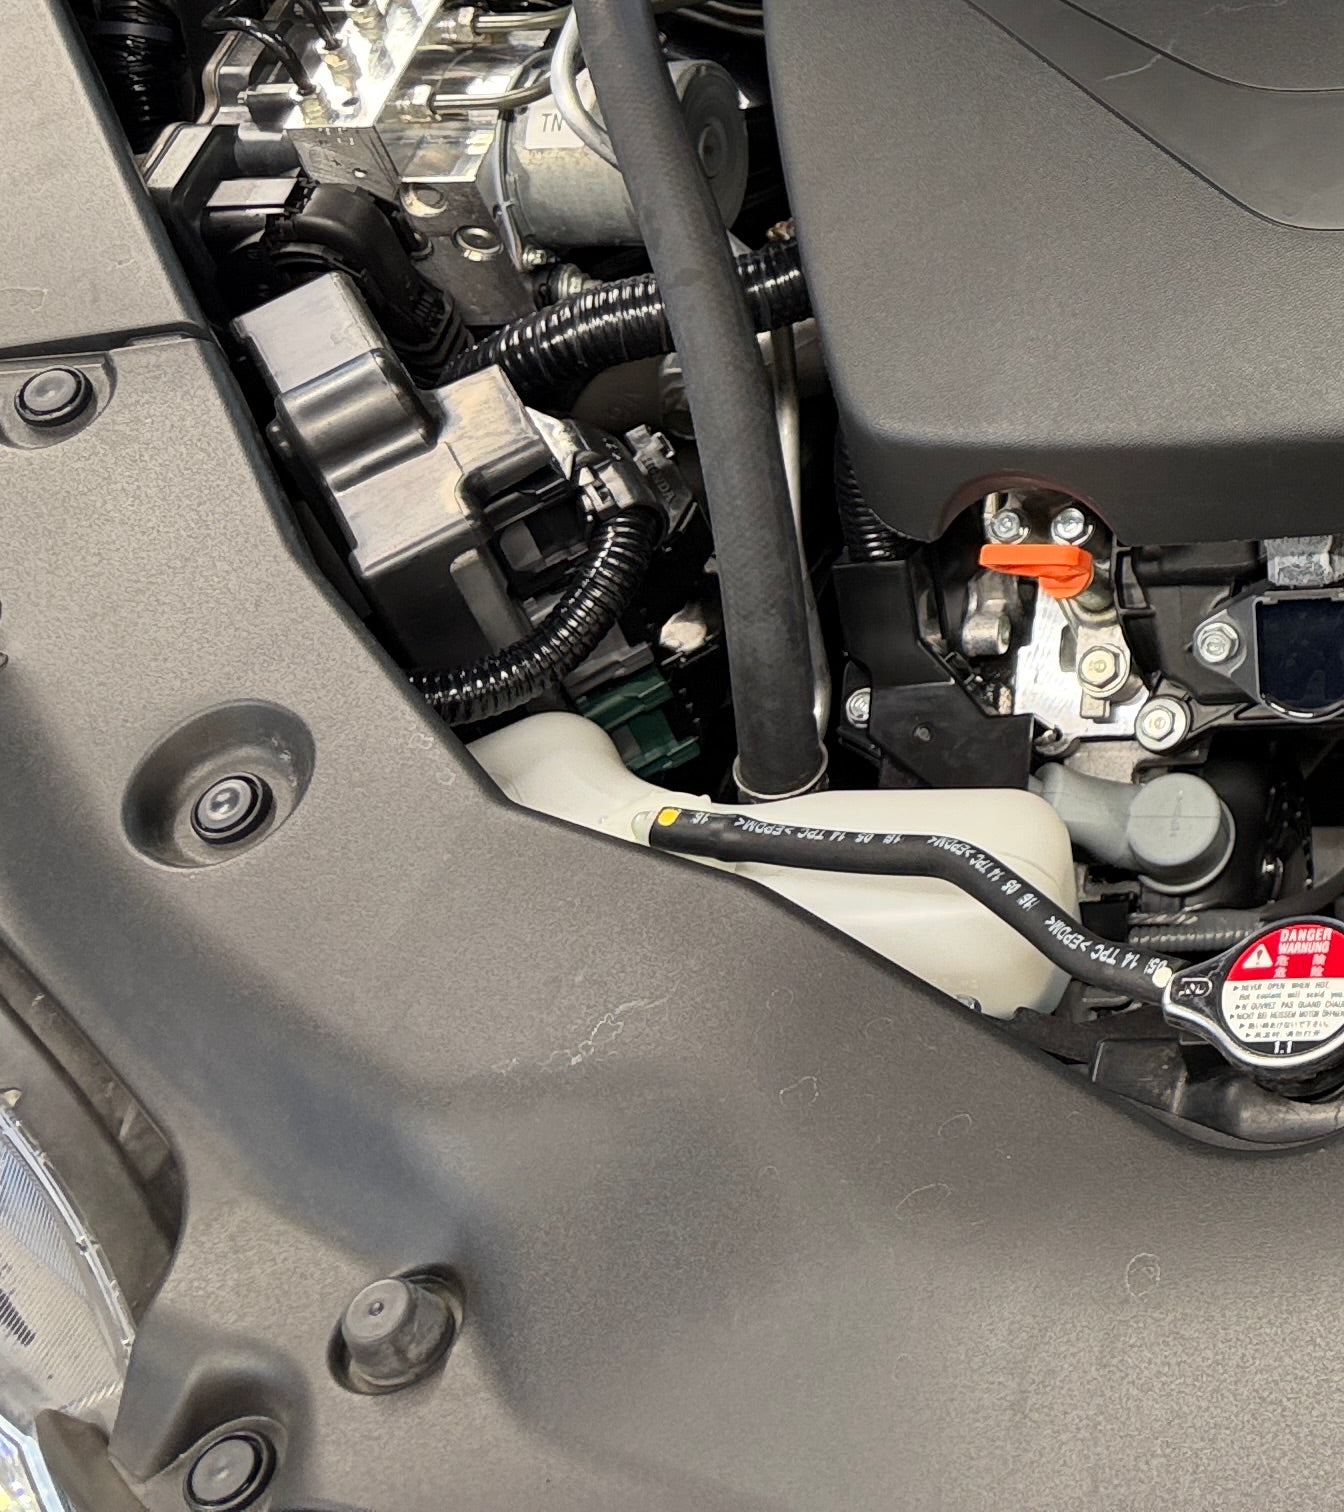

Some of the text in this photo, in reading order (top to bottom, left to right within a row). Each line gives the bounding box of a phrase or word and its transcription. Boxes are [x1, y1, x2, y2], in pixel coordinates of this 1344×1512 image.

[542, 112, 563, 132] TN
[1280, 928, 1333, 942] DANGER
[1090, 944, 1122, 966] TPC
[1278, 941, 1330, 954] WARNUNG
[1121, 951, 1140, 970] 14
[1274, 1041, 1293, 1054] 1.1
